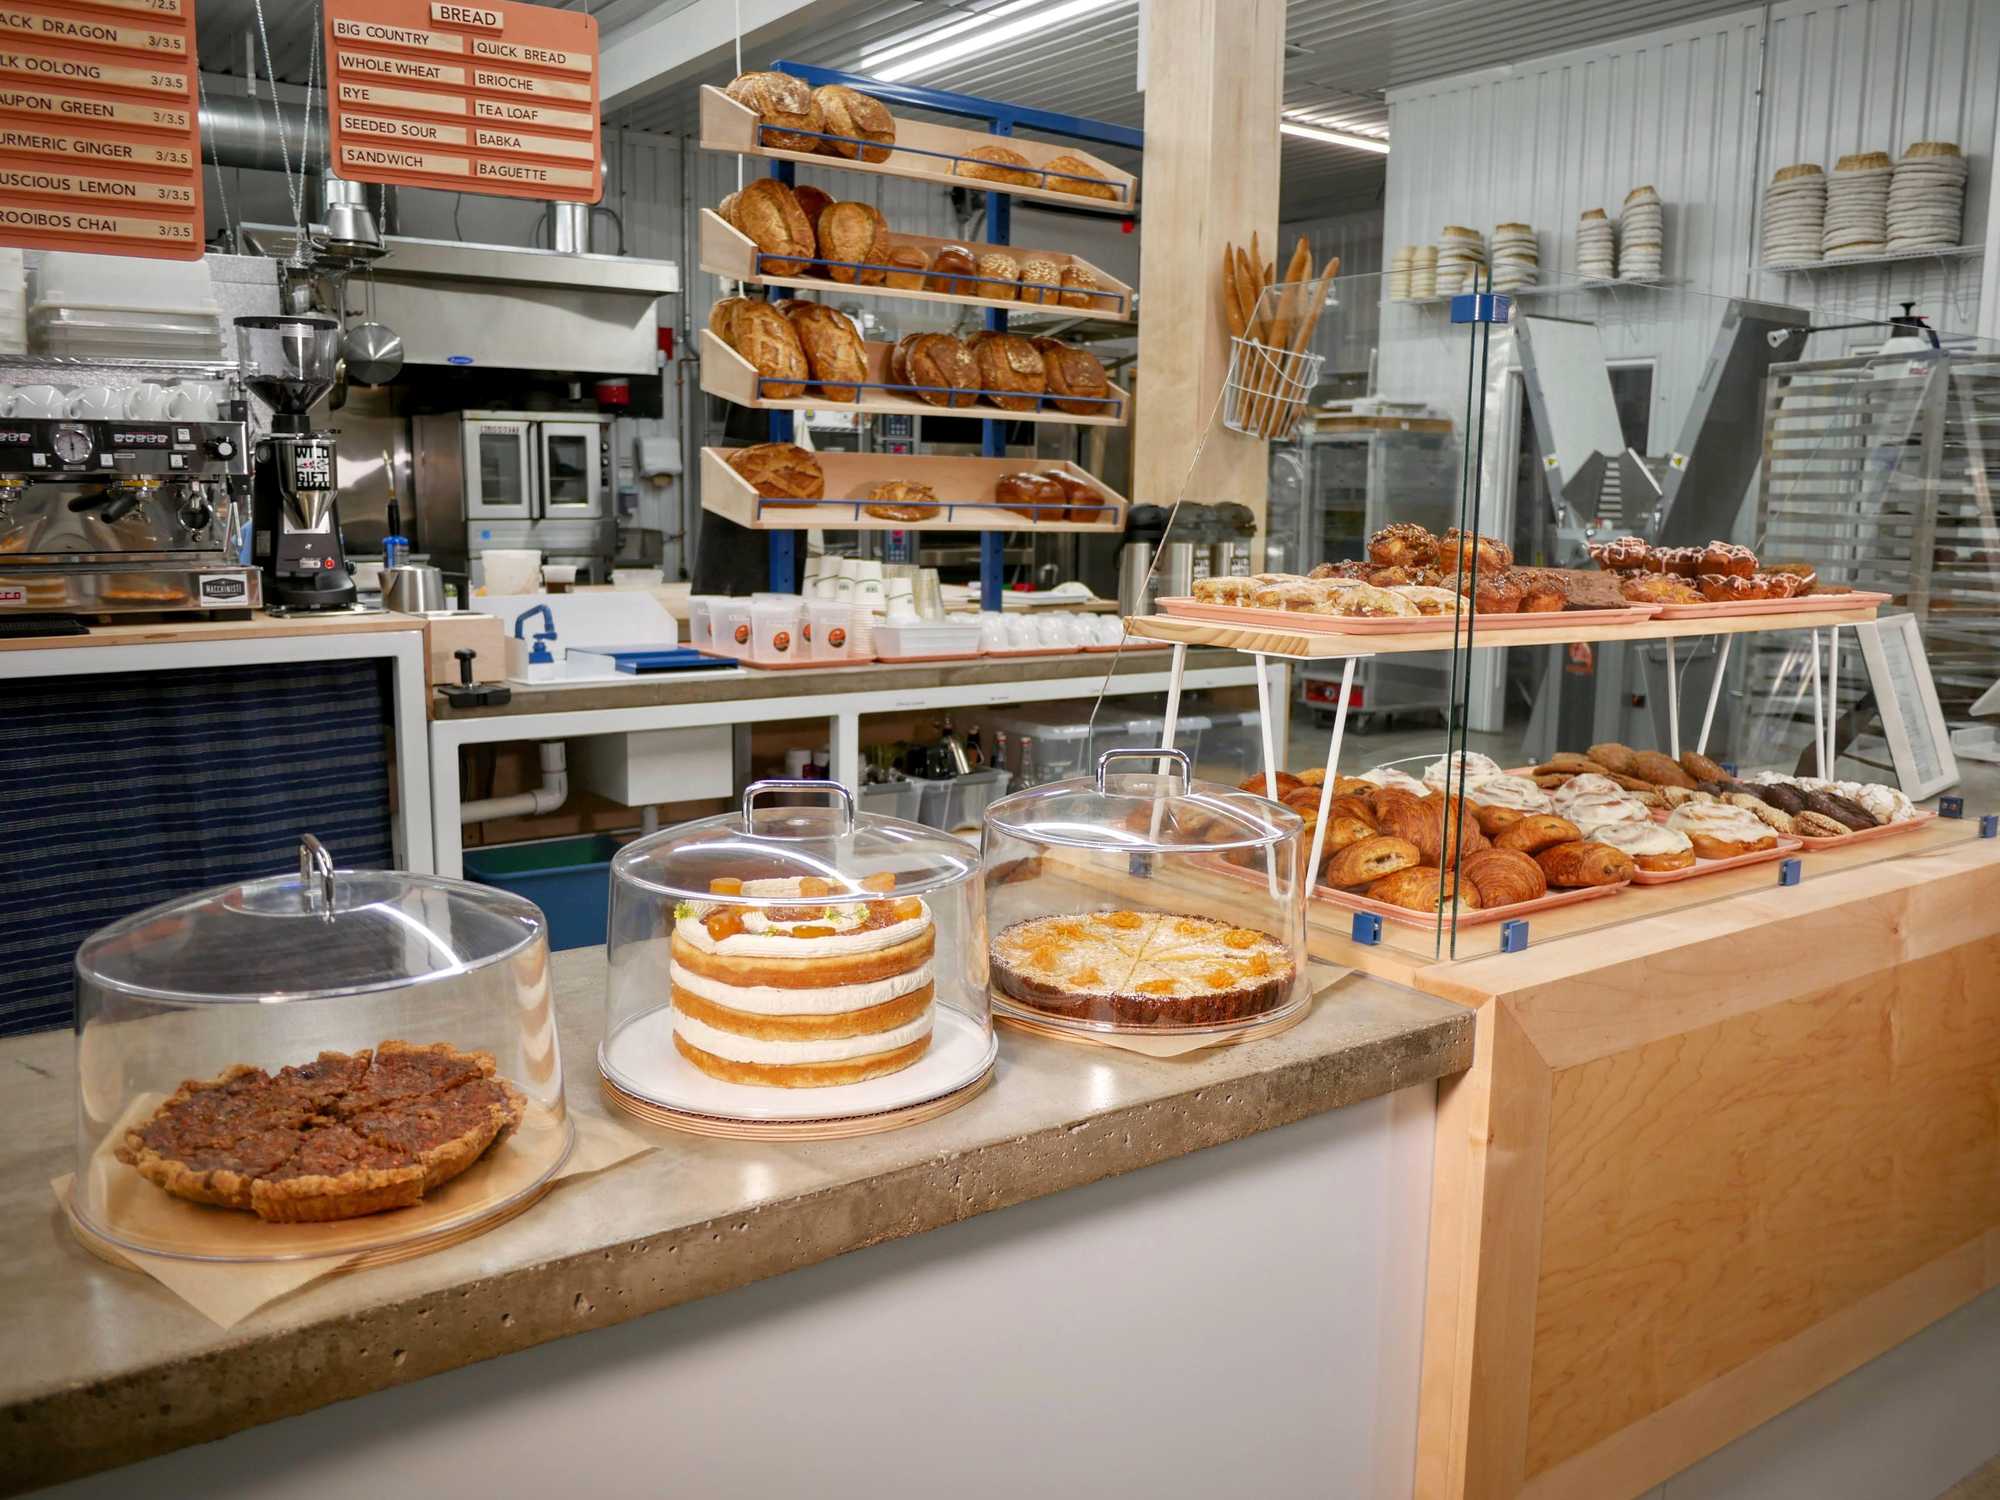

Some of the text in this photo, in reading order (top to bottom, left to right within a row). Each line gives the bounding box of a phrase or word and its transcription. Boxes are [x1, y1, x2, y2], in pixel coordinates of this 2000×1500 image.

[144, 0, 177, 10] /2.5
[440, 6, 497, 26] BREAD
[43, 19, 118, 42] DRAGON
[148, 35, 182, 50] 3/3.5
[337, 22, 430, 46] BIG COUNTRY
[476, 41, 567, 65] QUICK BREAD
[25, 57, 100, 79] OOLONG
[151, 74, 183, 89] 3/3.5
[341, 55, 441, 79] WHOLE WHEAT
[477, 73, 534, 92] BRIOCHE
[343, 88, 369, 100] RYE
[61, 100, 115, 118] GREEN
[153, 112, 185, 125] 3/3.5
[477, 103, 539, 121] TEA LOAF
[344, 116, 438, 139] SEEDED SOUR
[73, 139, 133, 159] GINGER
[156, 151, 187, 163] 3/3.5
[479, 133, 522, 149] BABKA
[346, 148, 424, 168] SANDWICH
[479, 163, 547, 182] BAGUETTE
[79, 180, 136, 197] LEMON
[158, 189, 190, 201] 3/3.5
[77, 216, 117, 233] CHAI
[159, 224, 191, 238] 3/3.5
[296, 471, 328, 482] GIFT
